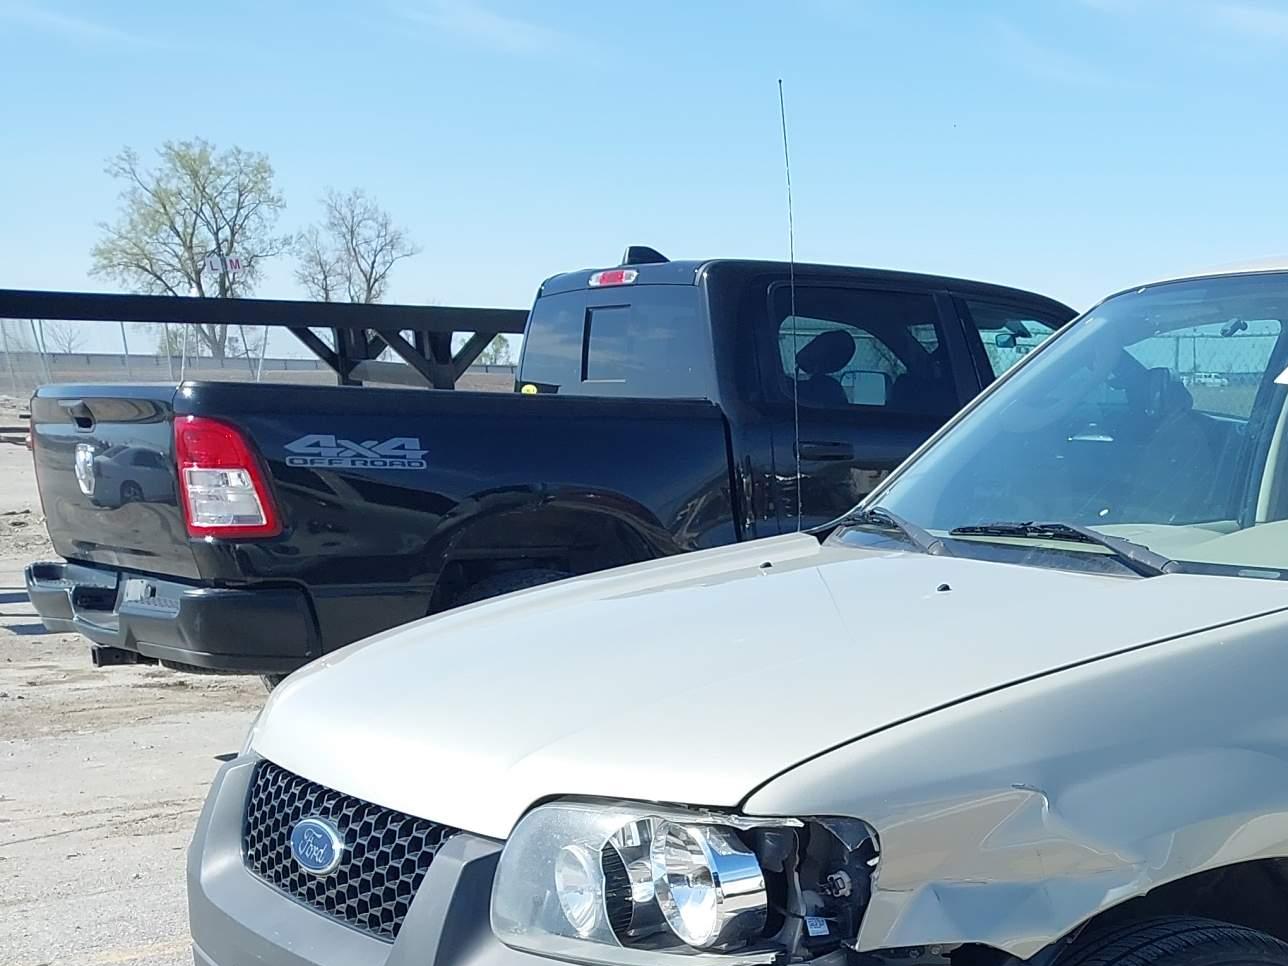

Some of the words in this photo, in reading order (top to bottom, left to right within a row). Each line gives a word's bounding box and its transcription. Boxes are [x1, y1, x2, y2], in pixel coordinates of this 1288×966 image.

[228, 258, 241, 270] M
[283, 433, 430, 459] 4x4
[289, 457, 345, 467] OFF
[351, 458, 425, 468] ROAD
[298, 827, 328, 864] Ford
